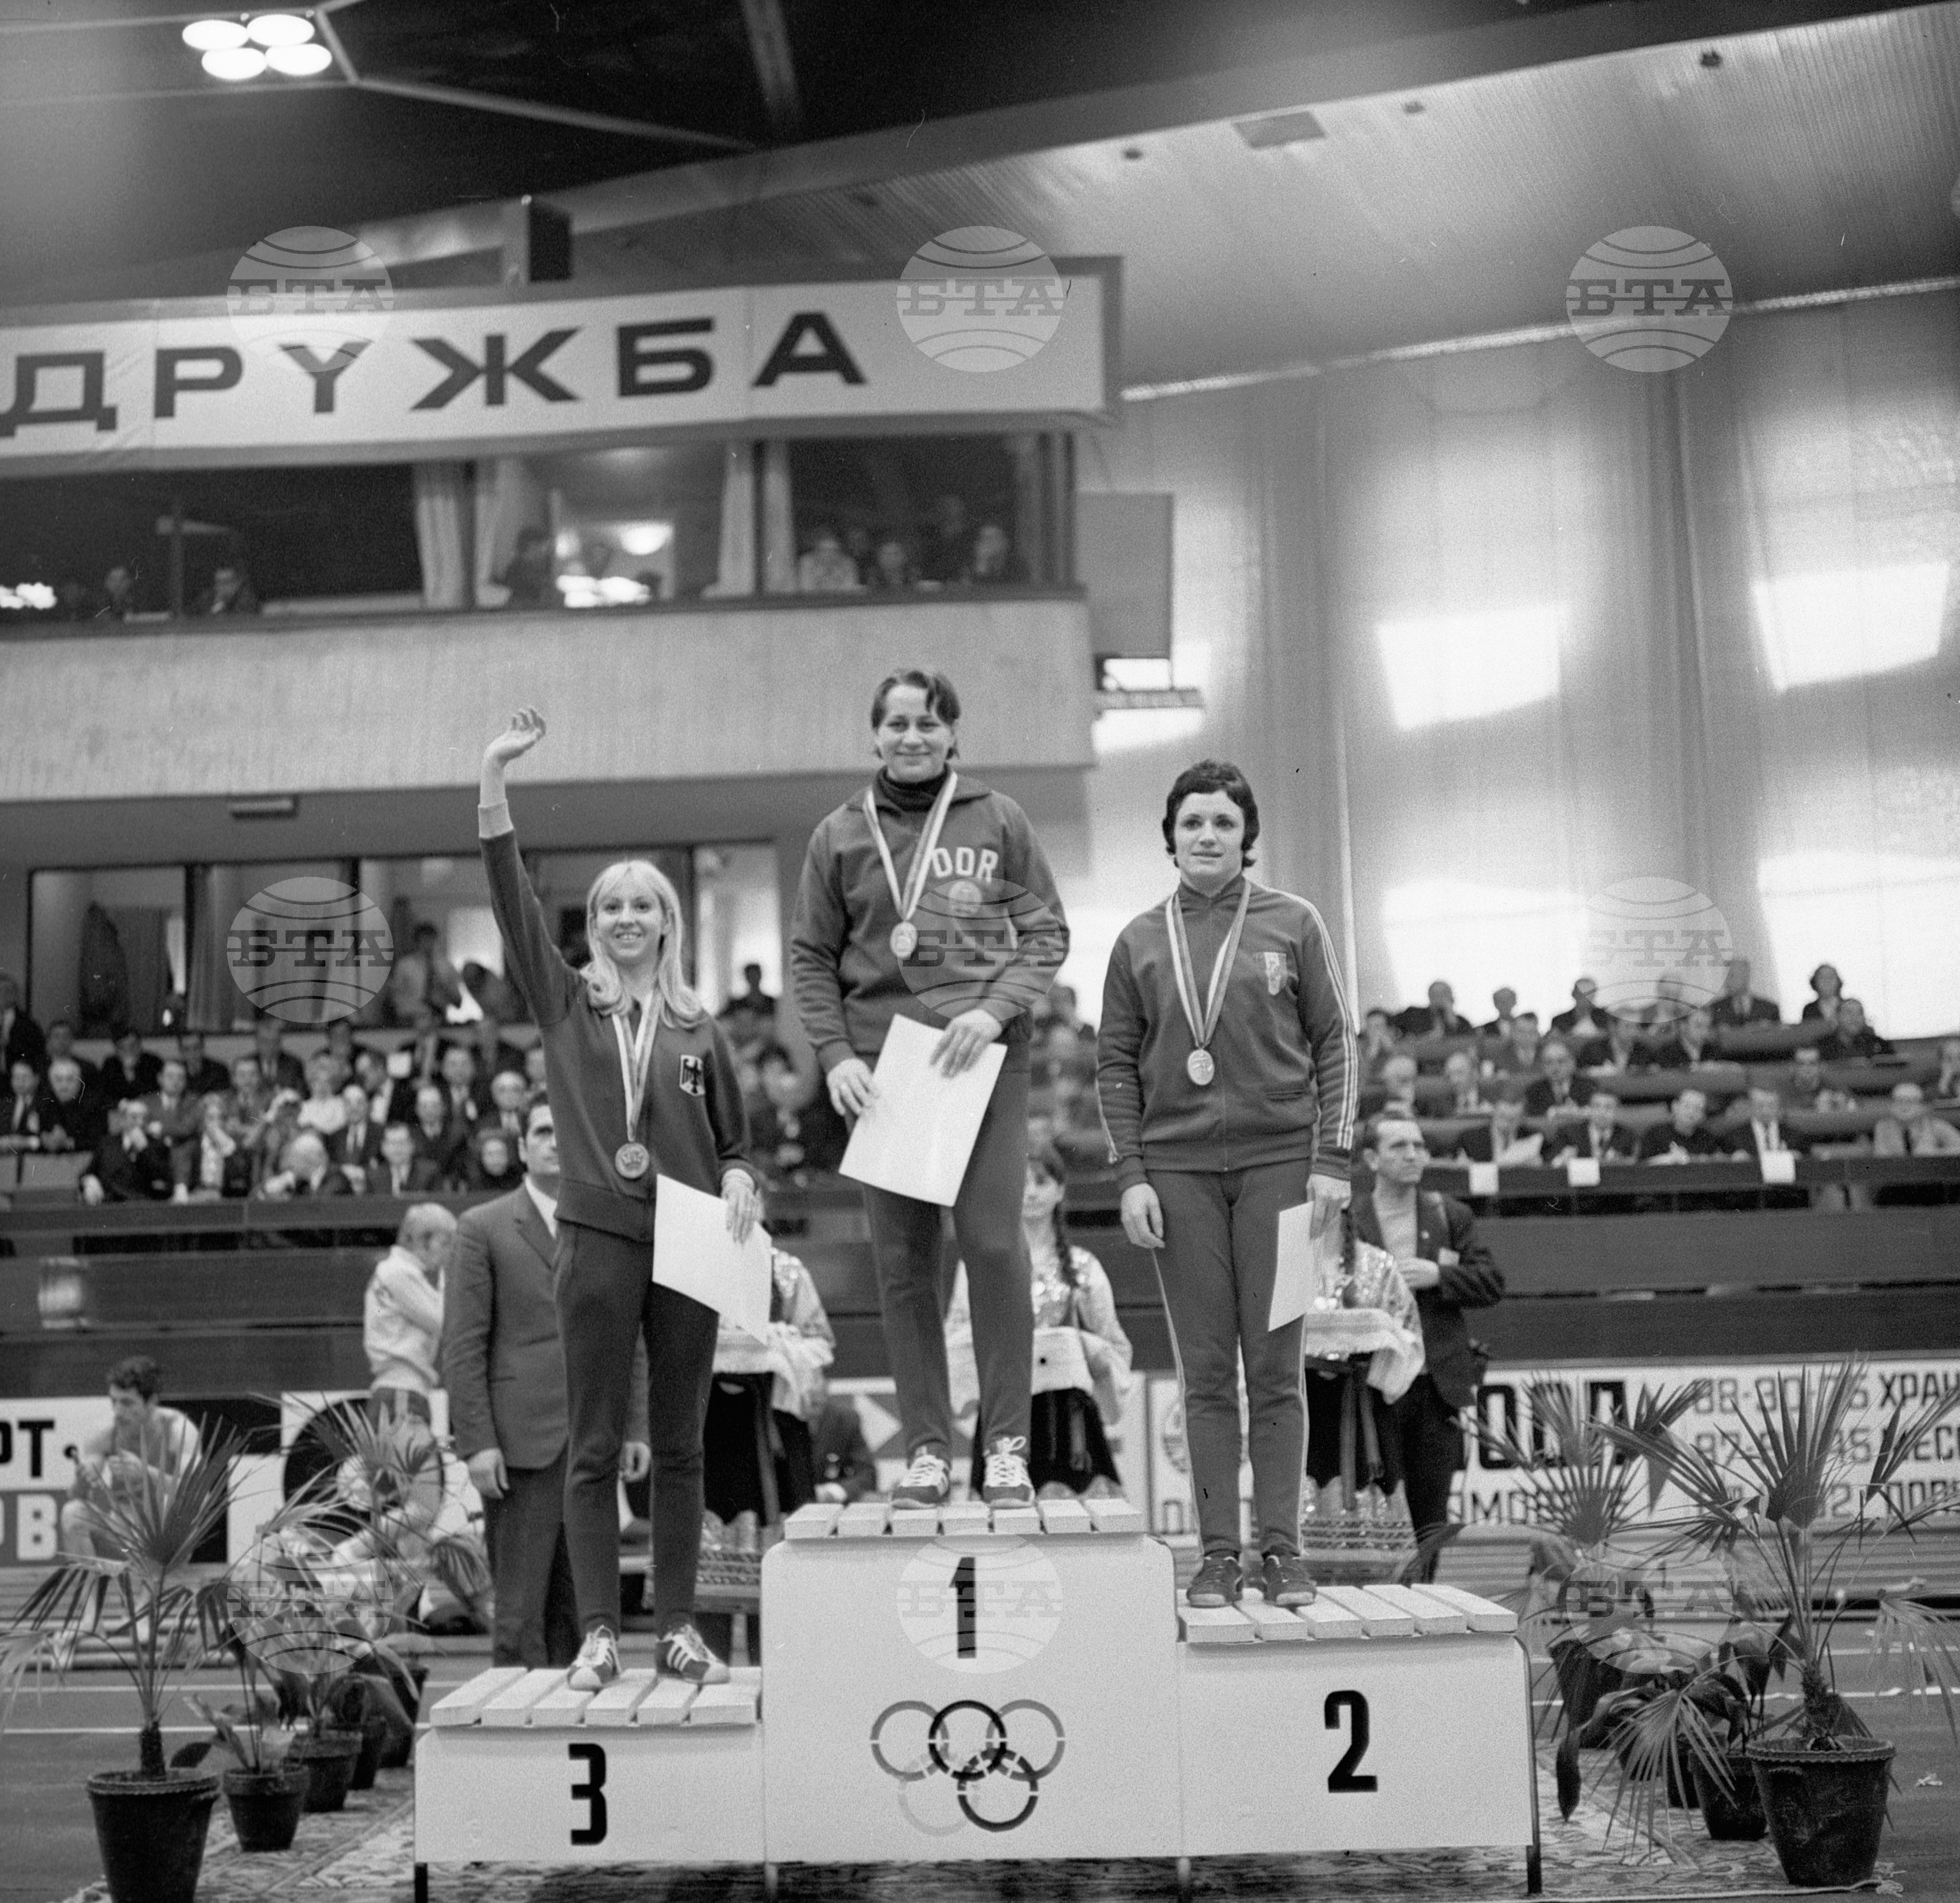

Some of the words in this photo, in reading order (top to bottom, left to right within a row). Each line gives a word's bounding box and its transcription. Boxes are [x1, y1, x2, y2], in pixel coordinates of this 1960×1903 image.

[0, 312, 868, 438] ДРУЖБА
[931, 846, 999, 884] DDR
[949, 1556, 976, 1659] 1
[1324, 1689, 1378, 1793] 2
[568, 1743, 608, 1846] 3
